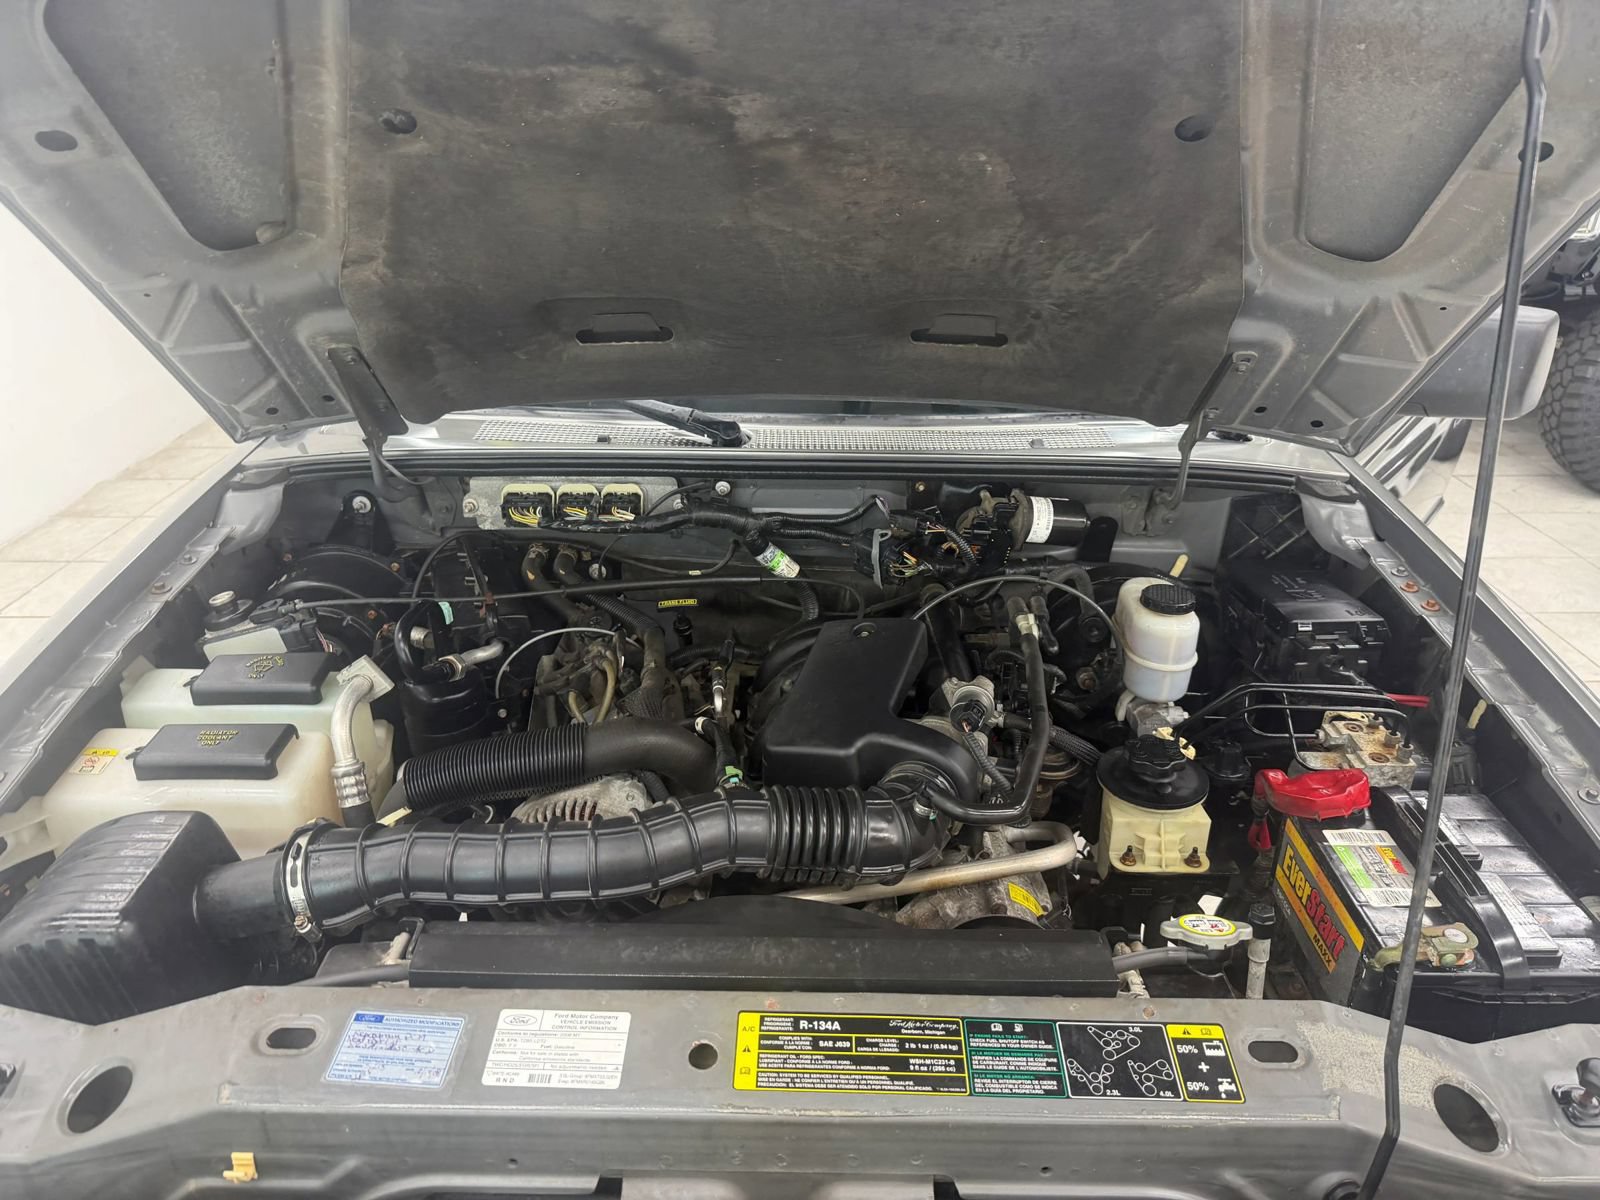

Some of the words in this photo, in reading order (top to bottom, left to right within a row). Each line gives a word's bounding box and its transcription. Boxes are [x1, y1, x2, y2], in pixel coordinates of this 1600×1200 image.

[1283, 843, 1345, 960] EverStart
[1312, 934, 1331, 964] MAXX
[419, 1019, 460, 1027] MODIFICATIONS
[510, 1016, 531, 1024] Ford
[800, 1020, 841, 1031] R-134A
[1177, 1045, 1198, 1053] 50%
[1187, 1082, 1209, 1091] 50%
